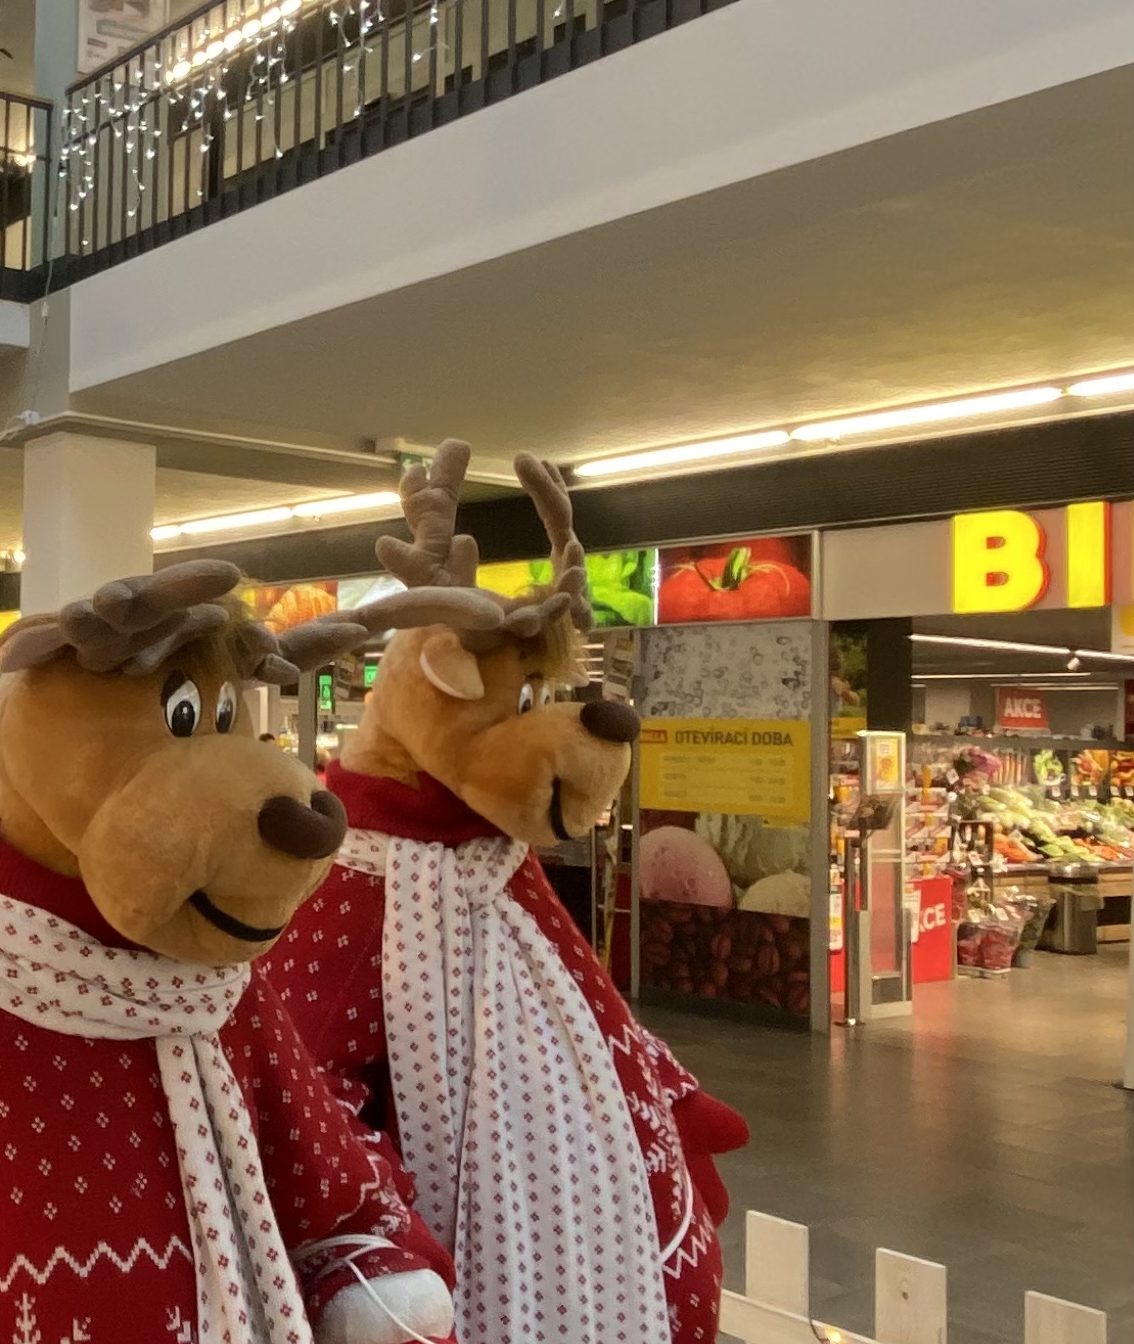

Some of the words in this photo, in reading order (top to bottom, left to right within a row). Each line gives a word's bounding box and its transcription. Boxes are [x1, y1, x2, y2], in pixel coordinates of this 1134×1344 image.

[1004, 696, 1042, 718] AKCE
[674, 725, 748, 746] OTEVÍRACÍ
[751, 731, 794, 747] DOBA
